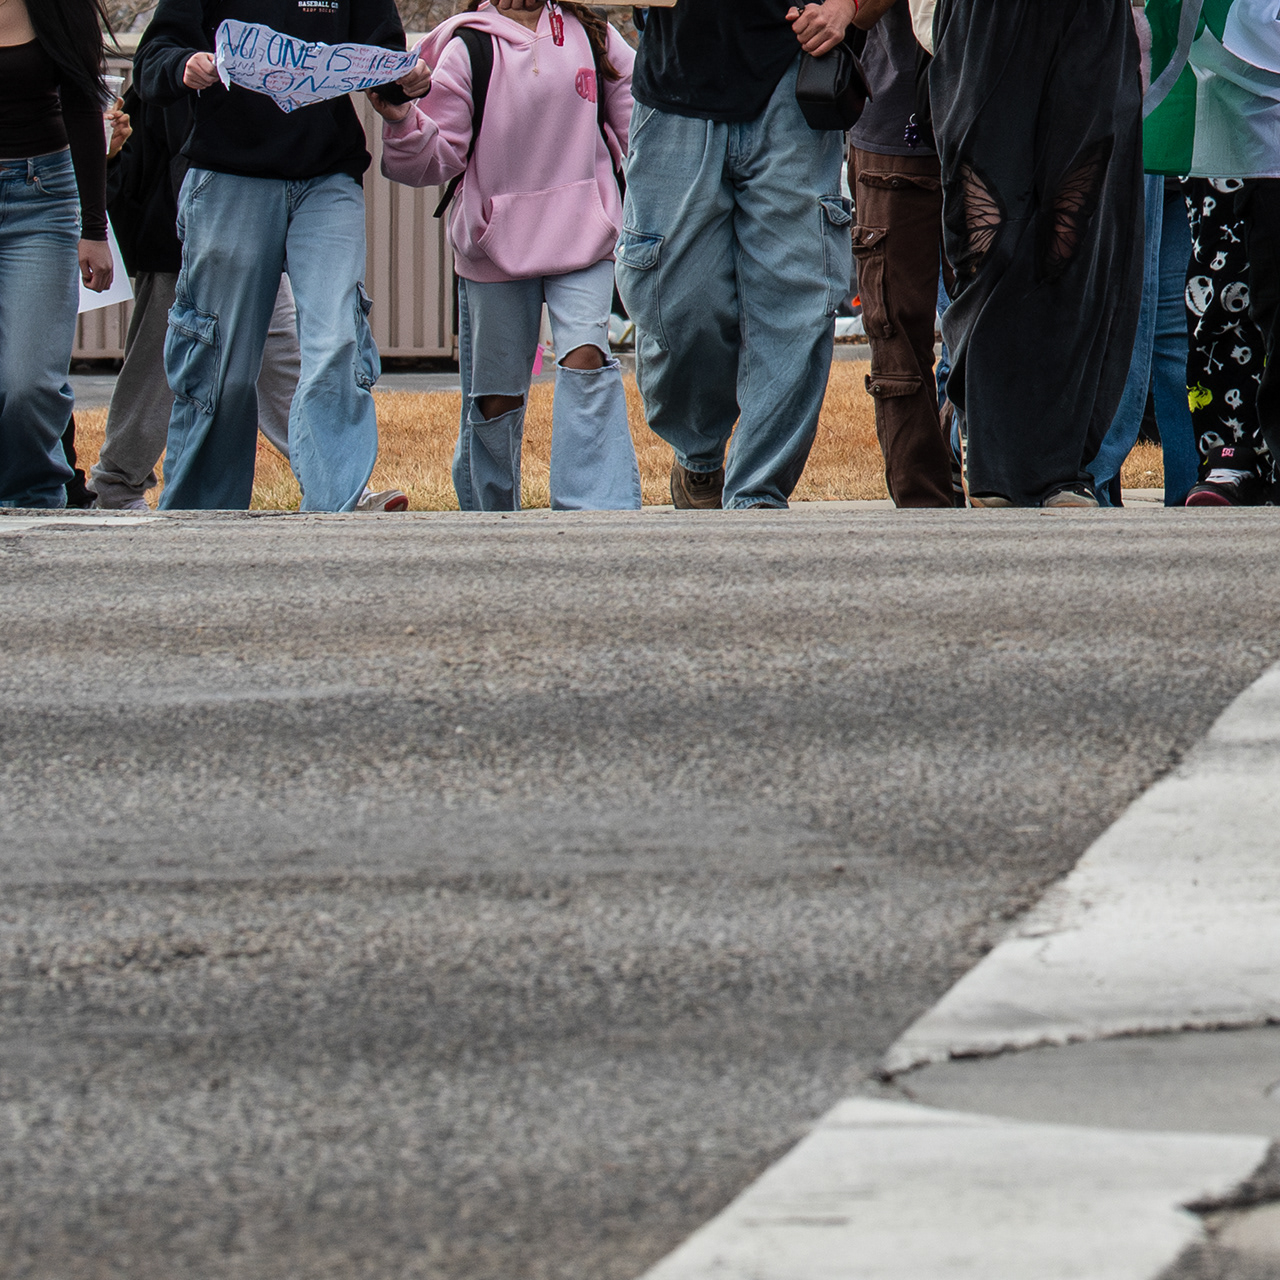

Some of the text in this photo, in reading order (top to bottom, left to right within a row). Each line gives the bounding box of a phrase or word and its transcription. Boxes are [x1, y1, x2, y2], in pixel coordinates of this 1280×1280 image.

[222, 23, 259, 59] NO
[267, 34, 317, 70] ONE
[326, 47, 355, 71] IS
[263, 70, 330, 93] ON
